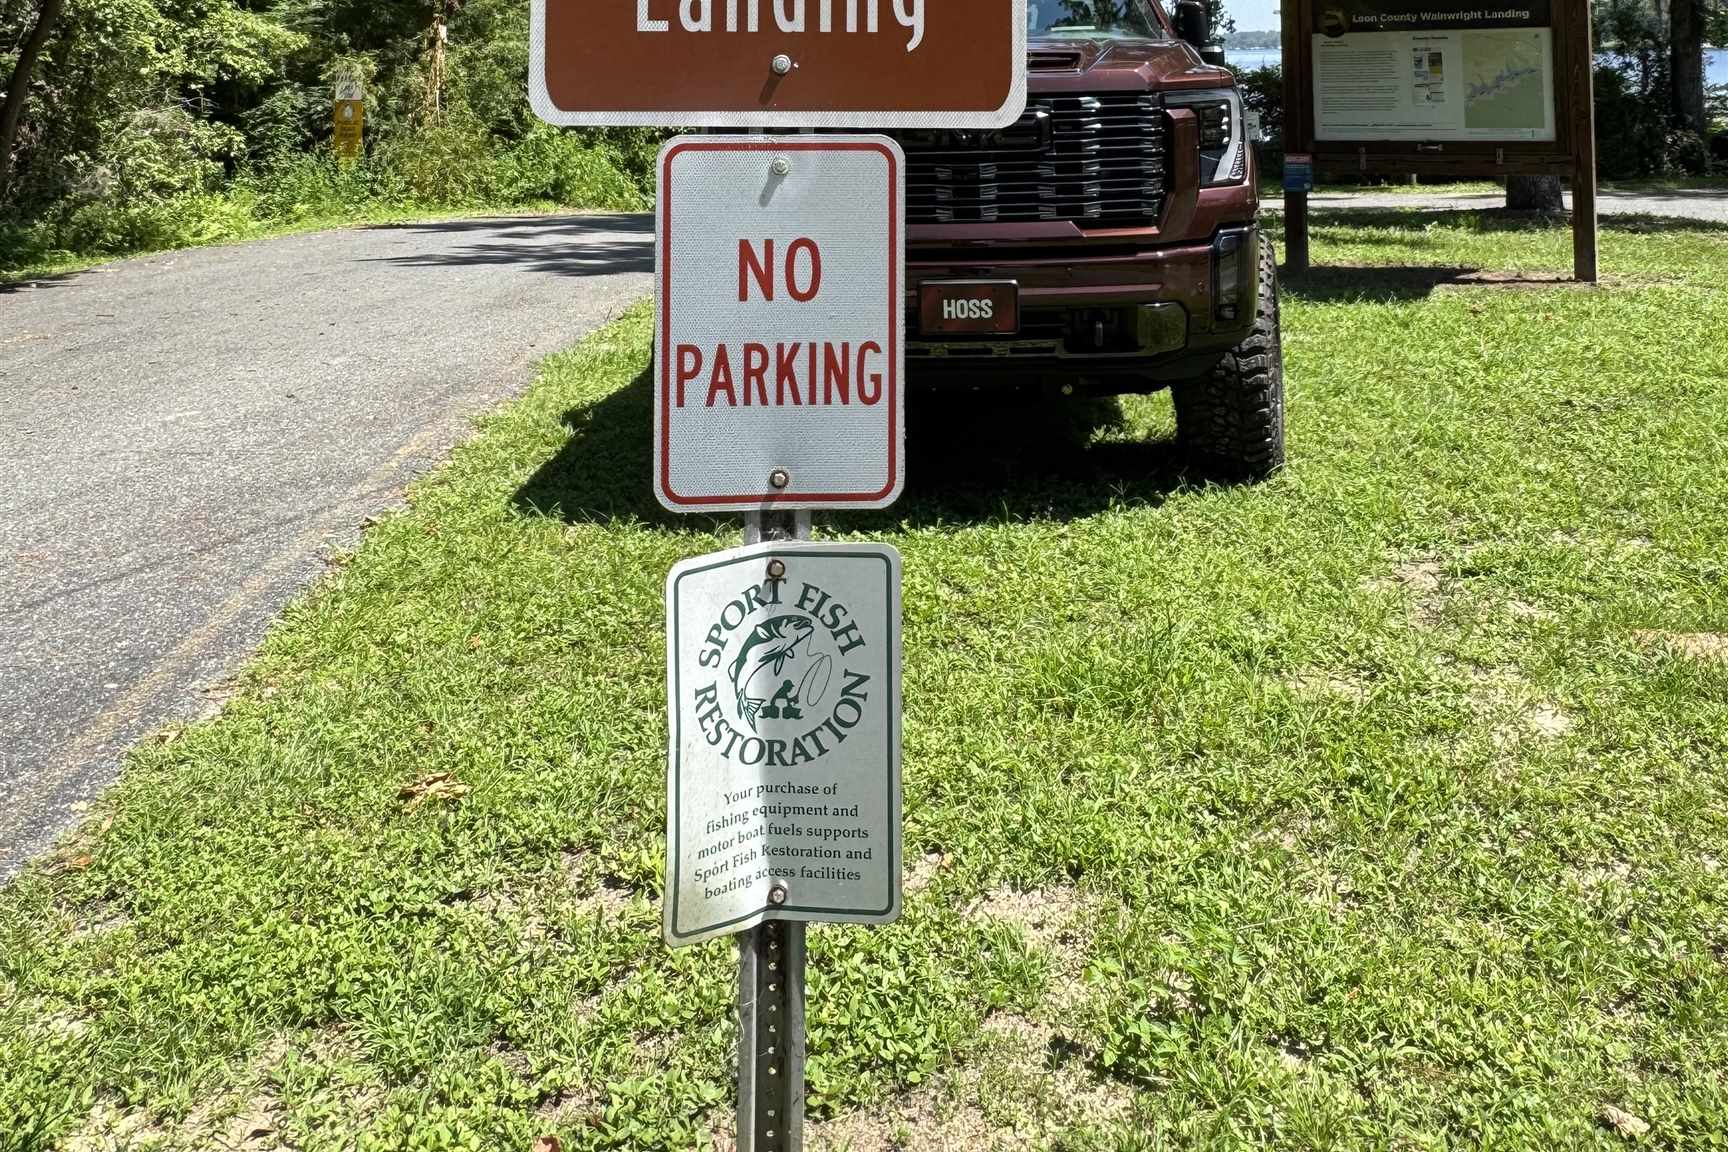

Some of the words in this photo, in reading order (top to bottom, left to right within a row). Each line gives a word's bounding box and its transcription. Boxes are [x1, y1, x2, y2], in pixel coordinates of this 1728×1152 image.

[1379, 12, 1418, 23] County
[1420, 10, 1483, 22] Wainwright
[1484, 9, 1530, 20] Landing
[738, 237, 823, 303] NO
[943, 298, 993, 320] HOSS
[675, 340, 883, 408] PARKING
[698, 577, 787, 669] SPORT
[794, 581, 867, 657] FISH
[694, 667, 872, 767] RESTORATION
[724, 786, 753, 805] Your
[756, 781, 820, 798] purchase
[823, 783, 838, 796] of
[706, 810, 750, 834] fishing
[752, 802, 830, 818] equipment
[832, 805, 859, 817] and
[697, 837, 735, 860] motor
[738, 826, 765, 844] boat
[768, 822, 803, 837] fuels
[806, 827, 869, 841] supports
[693, 861, 729, 883] Sport
[732, 849, 757, 868] Fish
[761, 844, 842, 859] Restoration
[845, 847, 873, 860] and
[704, 875, 752, 900] boating
[755, 866, 796, 881] access
[800, 865, 861, 881] facilities
